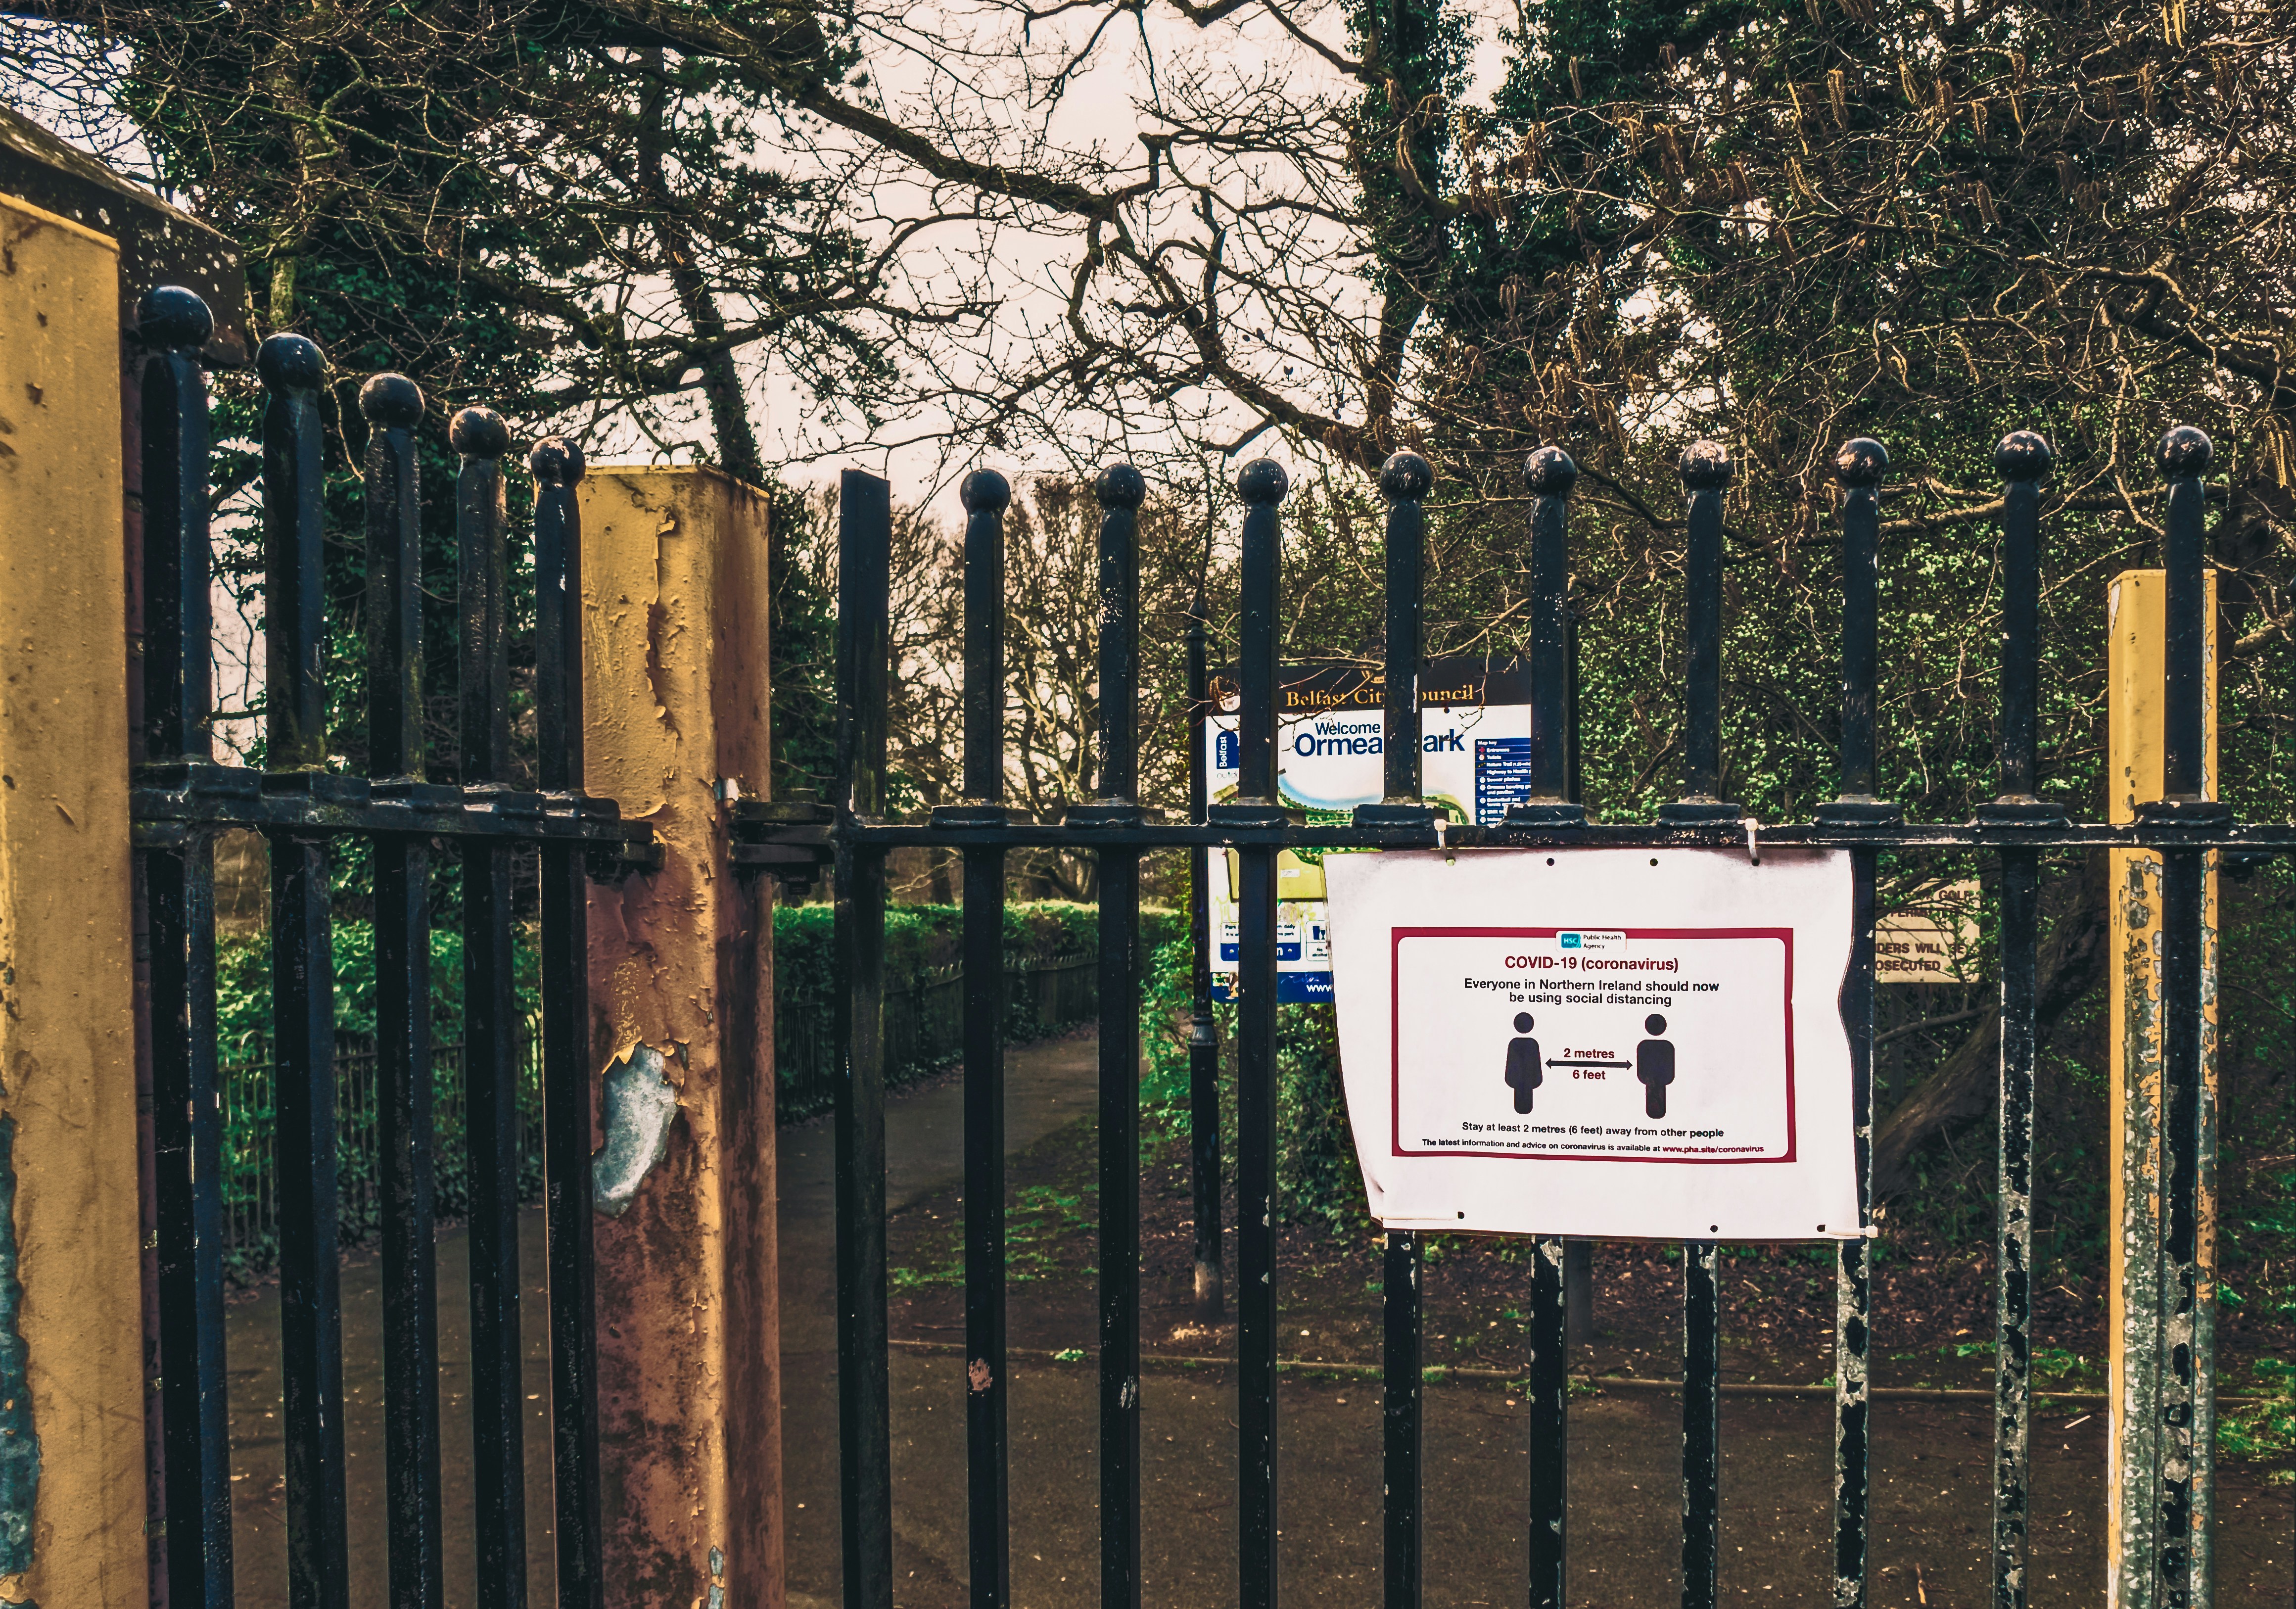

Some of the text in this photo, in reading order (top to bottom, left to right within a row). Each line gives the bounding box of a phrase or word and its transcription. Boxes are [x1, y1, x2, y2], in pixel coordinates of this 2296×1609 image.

[1286, 690, 1346, 706] Belfast
[1422, 684, 1473, 701] ouncil
[1315, 722, 1380, 735] Welcome
[1295, 728, 1465, 757] Ormea ark
[1875, 943, 1910, 953] DERS
[1915, 943, 1942, 953] WILL
[1505, 955, 1679, 973] COVID-19 (coronavirus)
[1875, 960, 1941, 971] OSECUTED
[1464, 978, 1720, 992] Everyone in Northern Ireland should now
[1509, 992, 1672, 1007] be using social distancing
[1563, 1047, 1615, 1059] 2 metres
[1572, 1069, 1606, 1080] 6 feet
[1462, 1122, 1484, 1133] Stay
[1498, 1123, 1521, 1132] least
[1523, 1124, 1529, 1133] 2
[1532, 1125, 1566, 1134] metres
[1569, 1125, 1578, 1136] (6
[1580, 1125, 1603, 1136] feet)
[1605, 1128, 1632, 1137] away
[1634, 1127, 1657, 1136] from
[1660, 1128, 1687, 1137] other
[1689, 1128, 1724, 1139] people
[1662, 1145, 1764, 1154] www.pha.site/coronavirus
